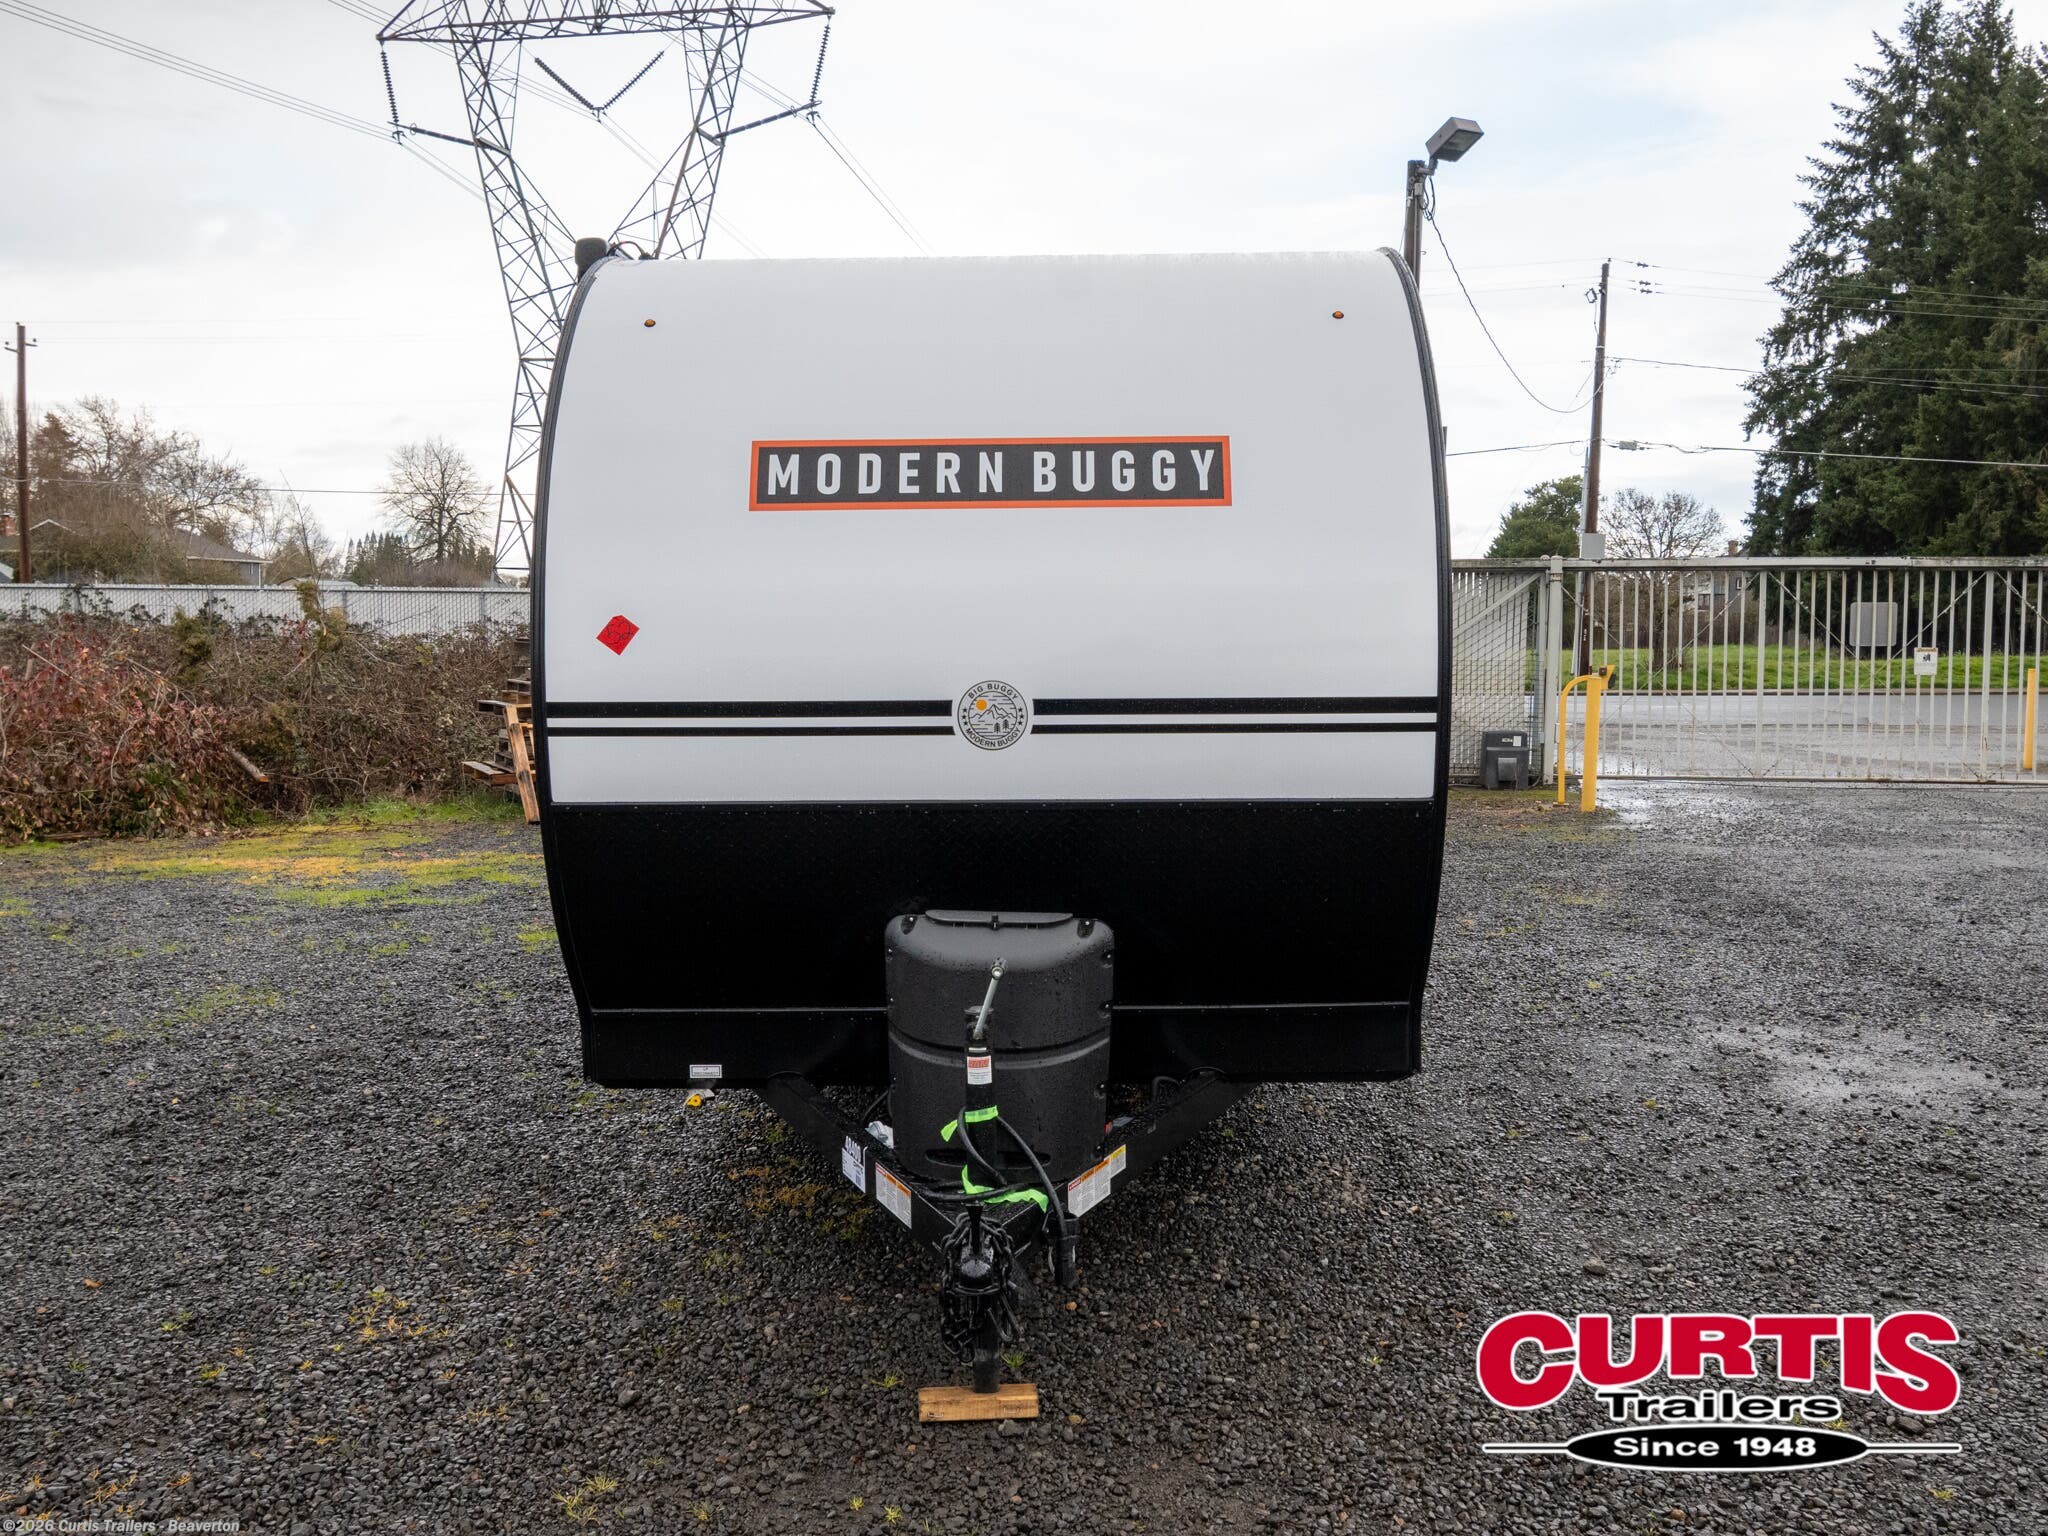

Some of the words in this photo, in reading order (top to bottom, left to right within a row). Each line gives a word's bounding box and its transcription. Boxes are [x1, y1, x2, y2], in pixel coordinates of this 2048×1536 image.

[768, 451, 1003, 495] MODERN
[1033, 449, 1215, 492] BUGGY
[968, 685, 984, 699] BIG
[987, 683, 1019, 699] BUGGY
[966, 728, 996, 747] MODERN
[997, 727, 1021, 747] BUGGY
